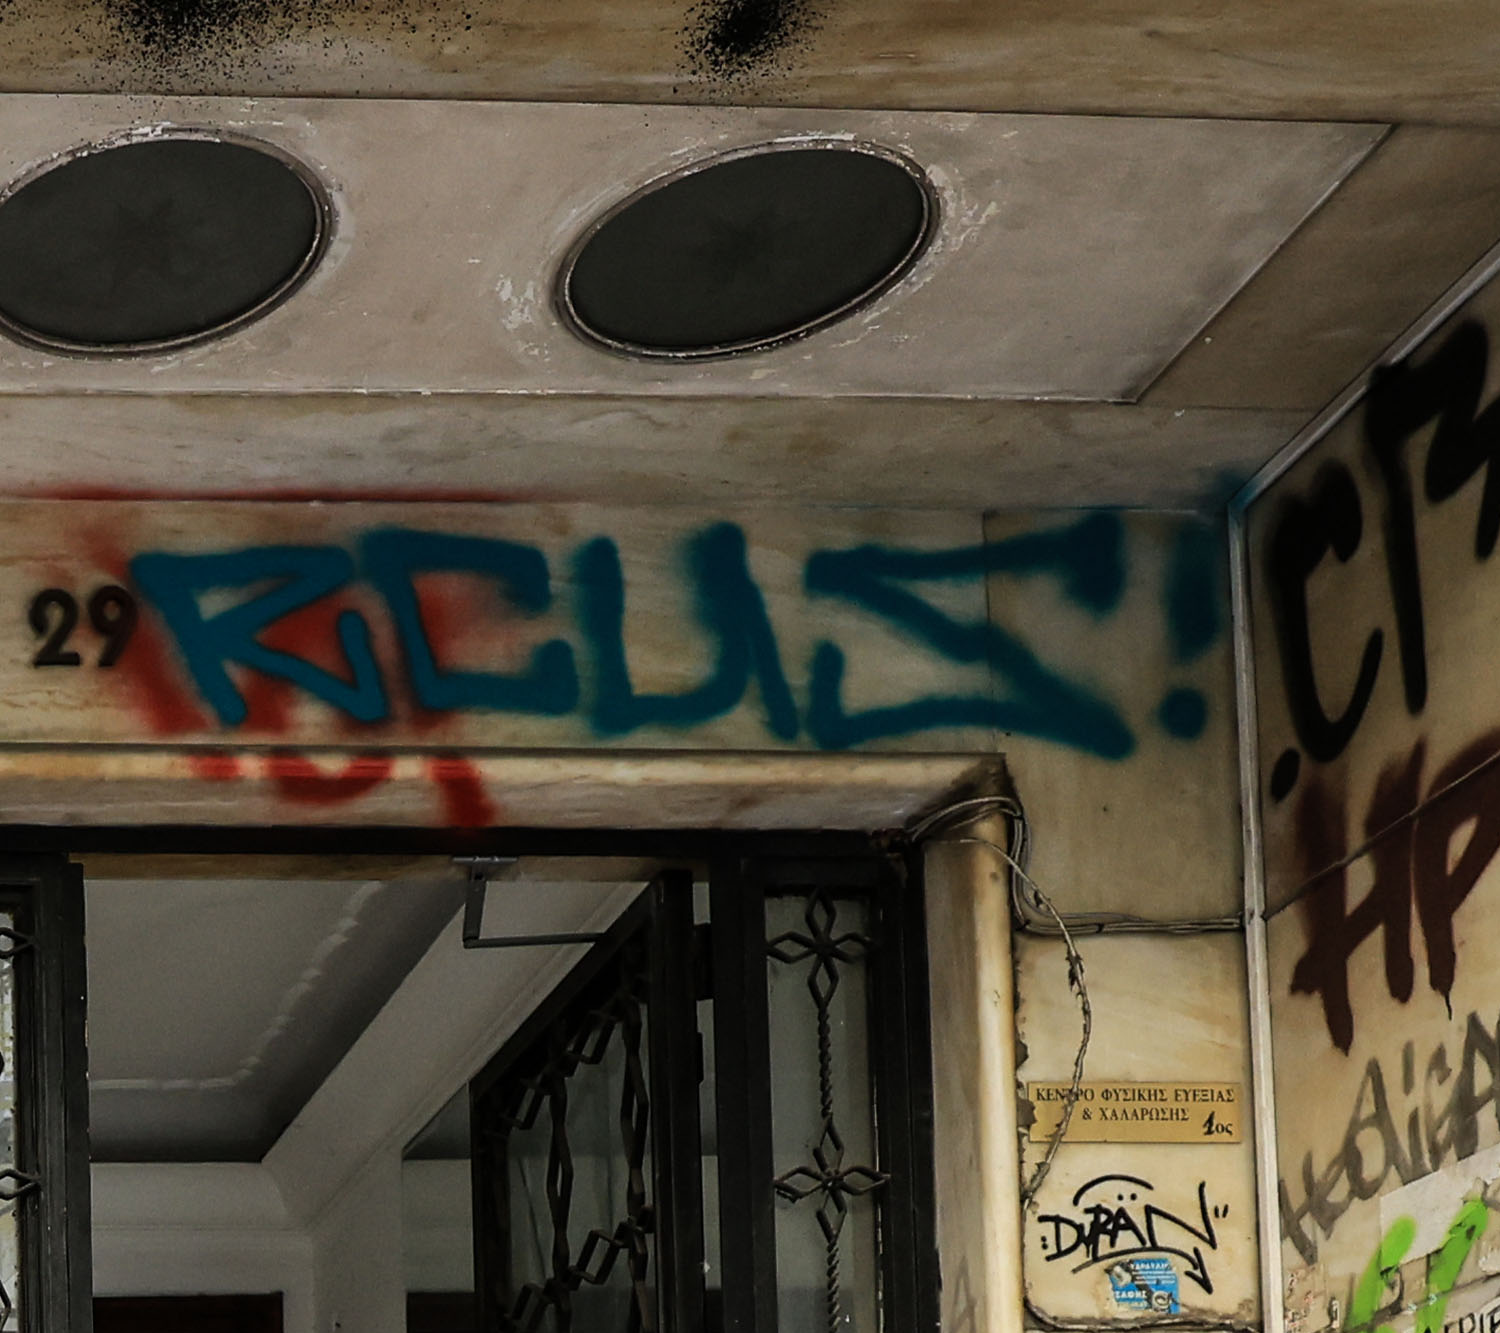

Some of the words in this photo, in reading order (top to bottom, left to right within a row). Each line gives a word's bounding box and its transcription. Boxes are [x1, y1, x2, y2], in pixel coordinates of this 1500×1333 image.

[26, 585, 138, 669] 29
[1101, 1087, 1168, 1102] ΦΥΣΙΚΗΣ
[1174, 1087, 1235, 1103] ΕΥΕΞΙΑΣ
[1082, 1107, 1092, 1121] &
[1099, 1107, 1190, 1121] ΧΑΛΑΡΩΣΗΣ
